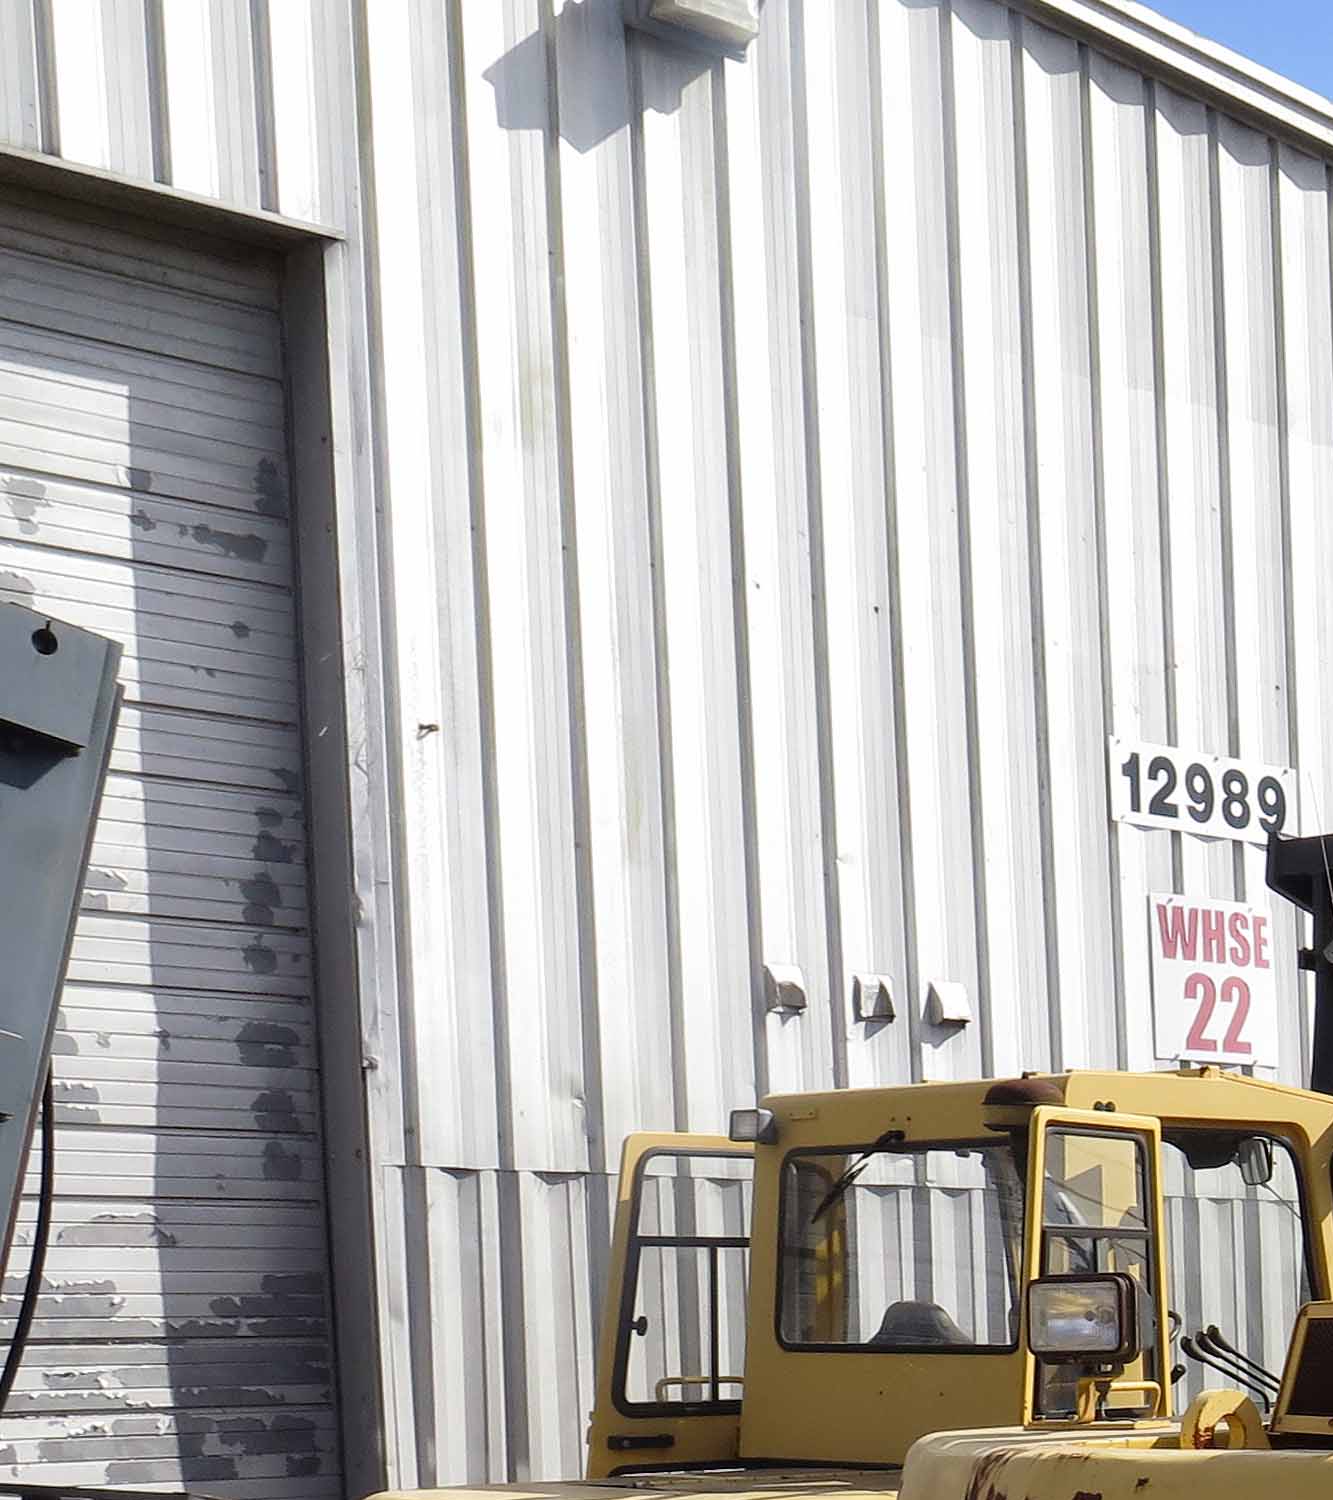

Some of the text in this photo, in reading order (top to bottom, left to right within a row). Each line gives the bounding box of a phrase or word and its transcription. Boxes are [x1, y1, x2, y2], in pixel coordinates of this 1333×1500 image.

[1120, 751, 1286, 834] 12989
[1156, 903, 1270, 969] WHSE
[1183, 972, 1252, 1054] 22
